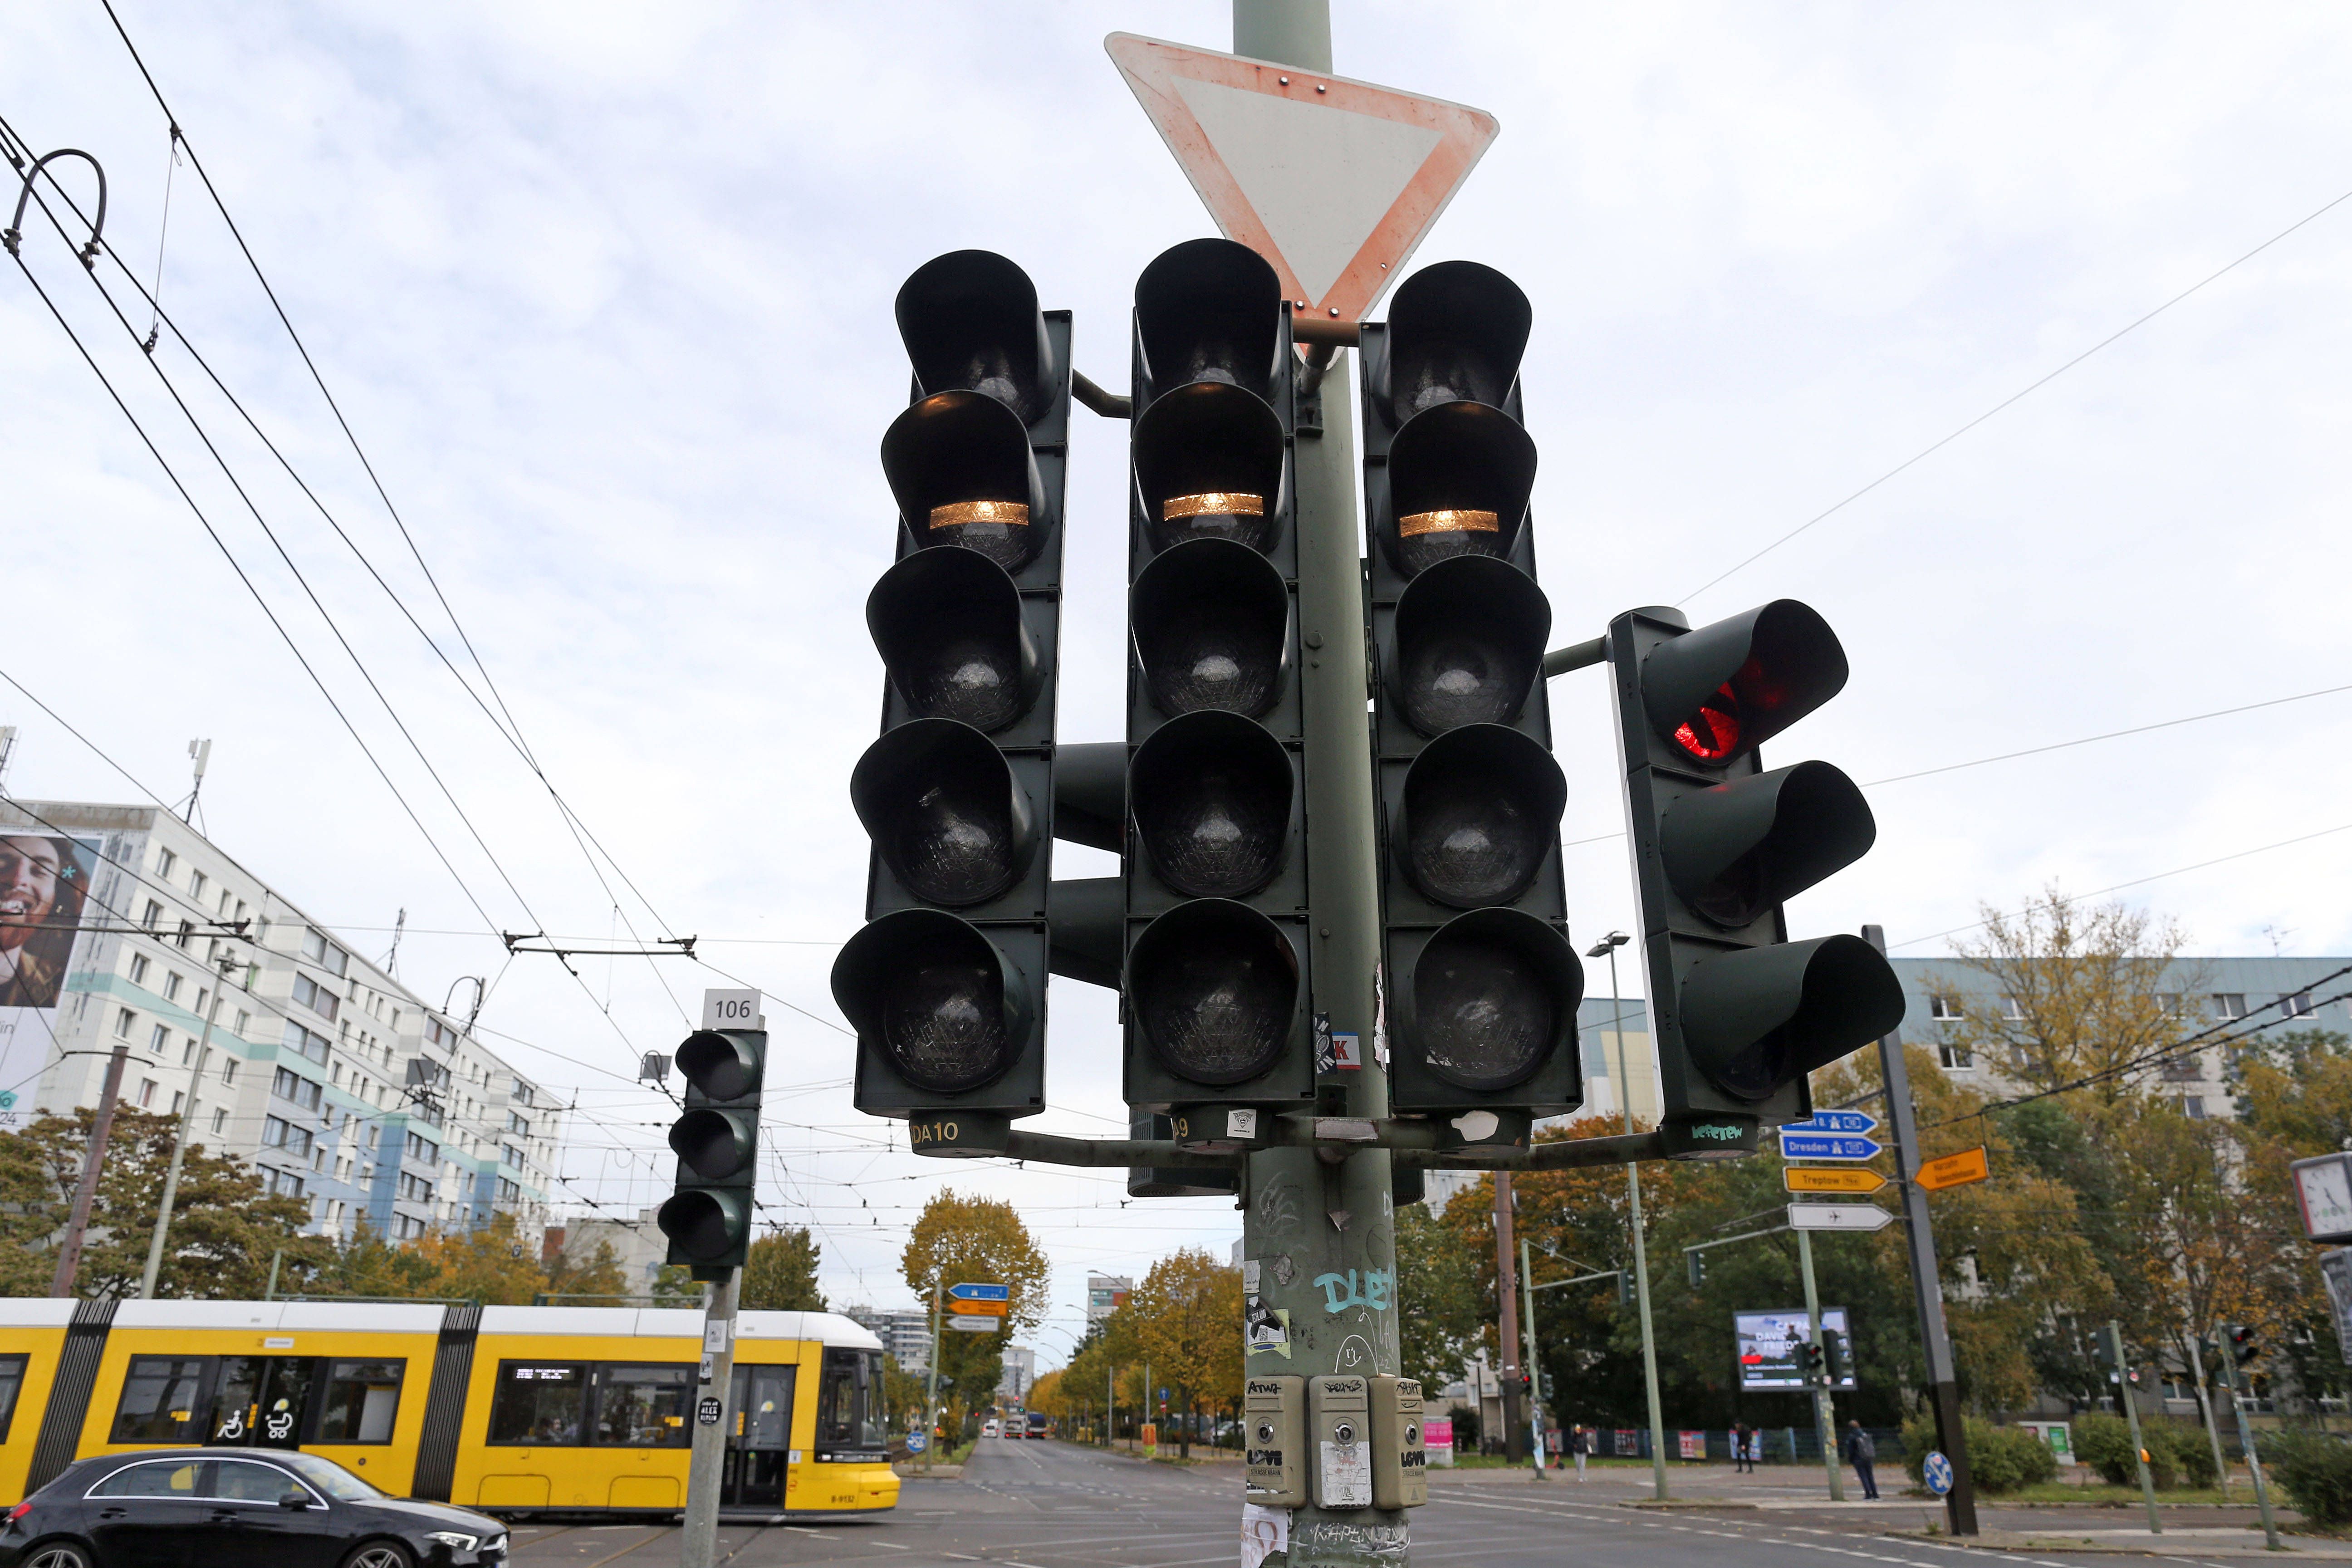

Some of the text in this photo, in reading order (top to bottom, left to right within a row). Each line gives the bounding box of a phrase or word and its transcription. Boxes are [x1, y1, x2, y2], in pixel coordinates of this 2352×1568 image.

[716, 1000, 750, 1018] 106
[1788, 1141, 1828, 1152] Dresden
[1803, 1175, 1839, 1185] Treptow
[1250, 1468, 1282, 1476] STRASSENBAHN
[1402, 1469, 1425, 1477] STRASSENBAHN
